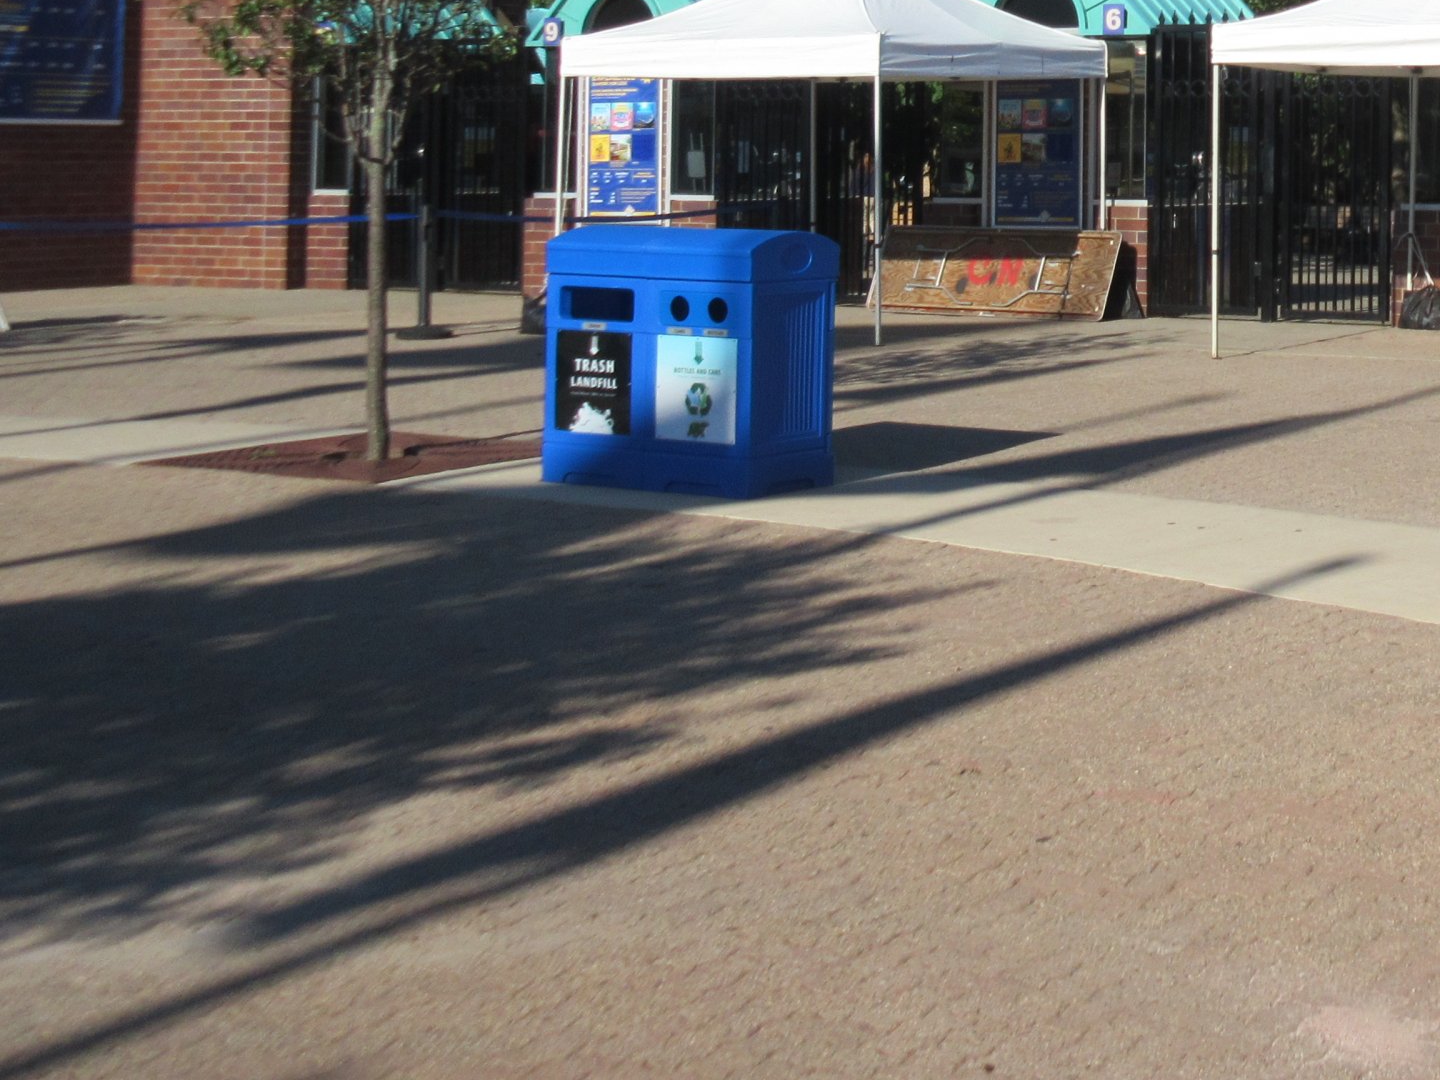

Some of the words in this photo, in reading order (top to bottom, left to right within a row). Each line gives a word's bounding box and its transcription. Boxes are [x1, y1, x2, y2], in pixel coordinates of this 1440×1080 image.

[1106, 8, 1122, 31] 6
[545, 21, 559, 42] 9
[574, 358, 615, 373] TRASH
[673, 367, 696, 375] BOTTLES
[570, 375, 618, 390] LANDFILL
